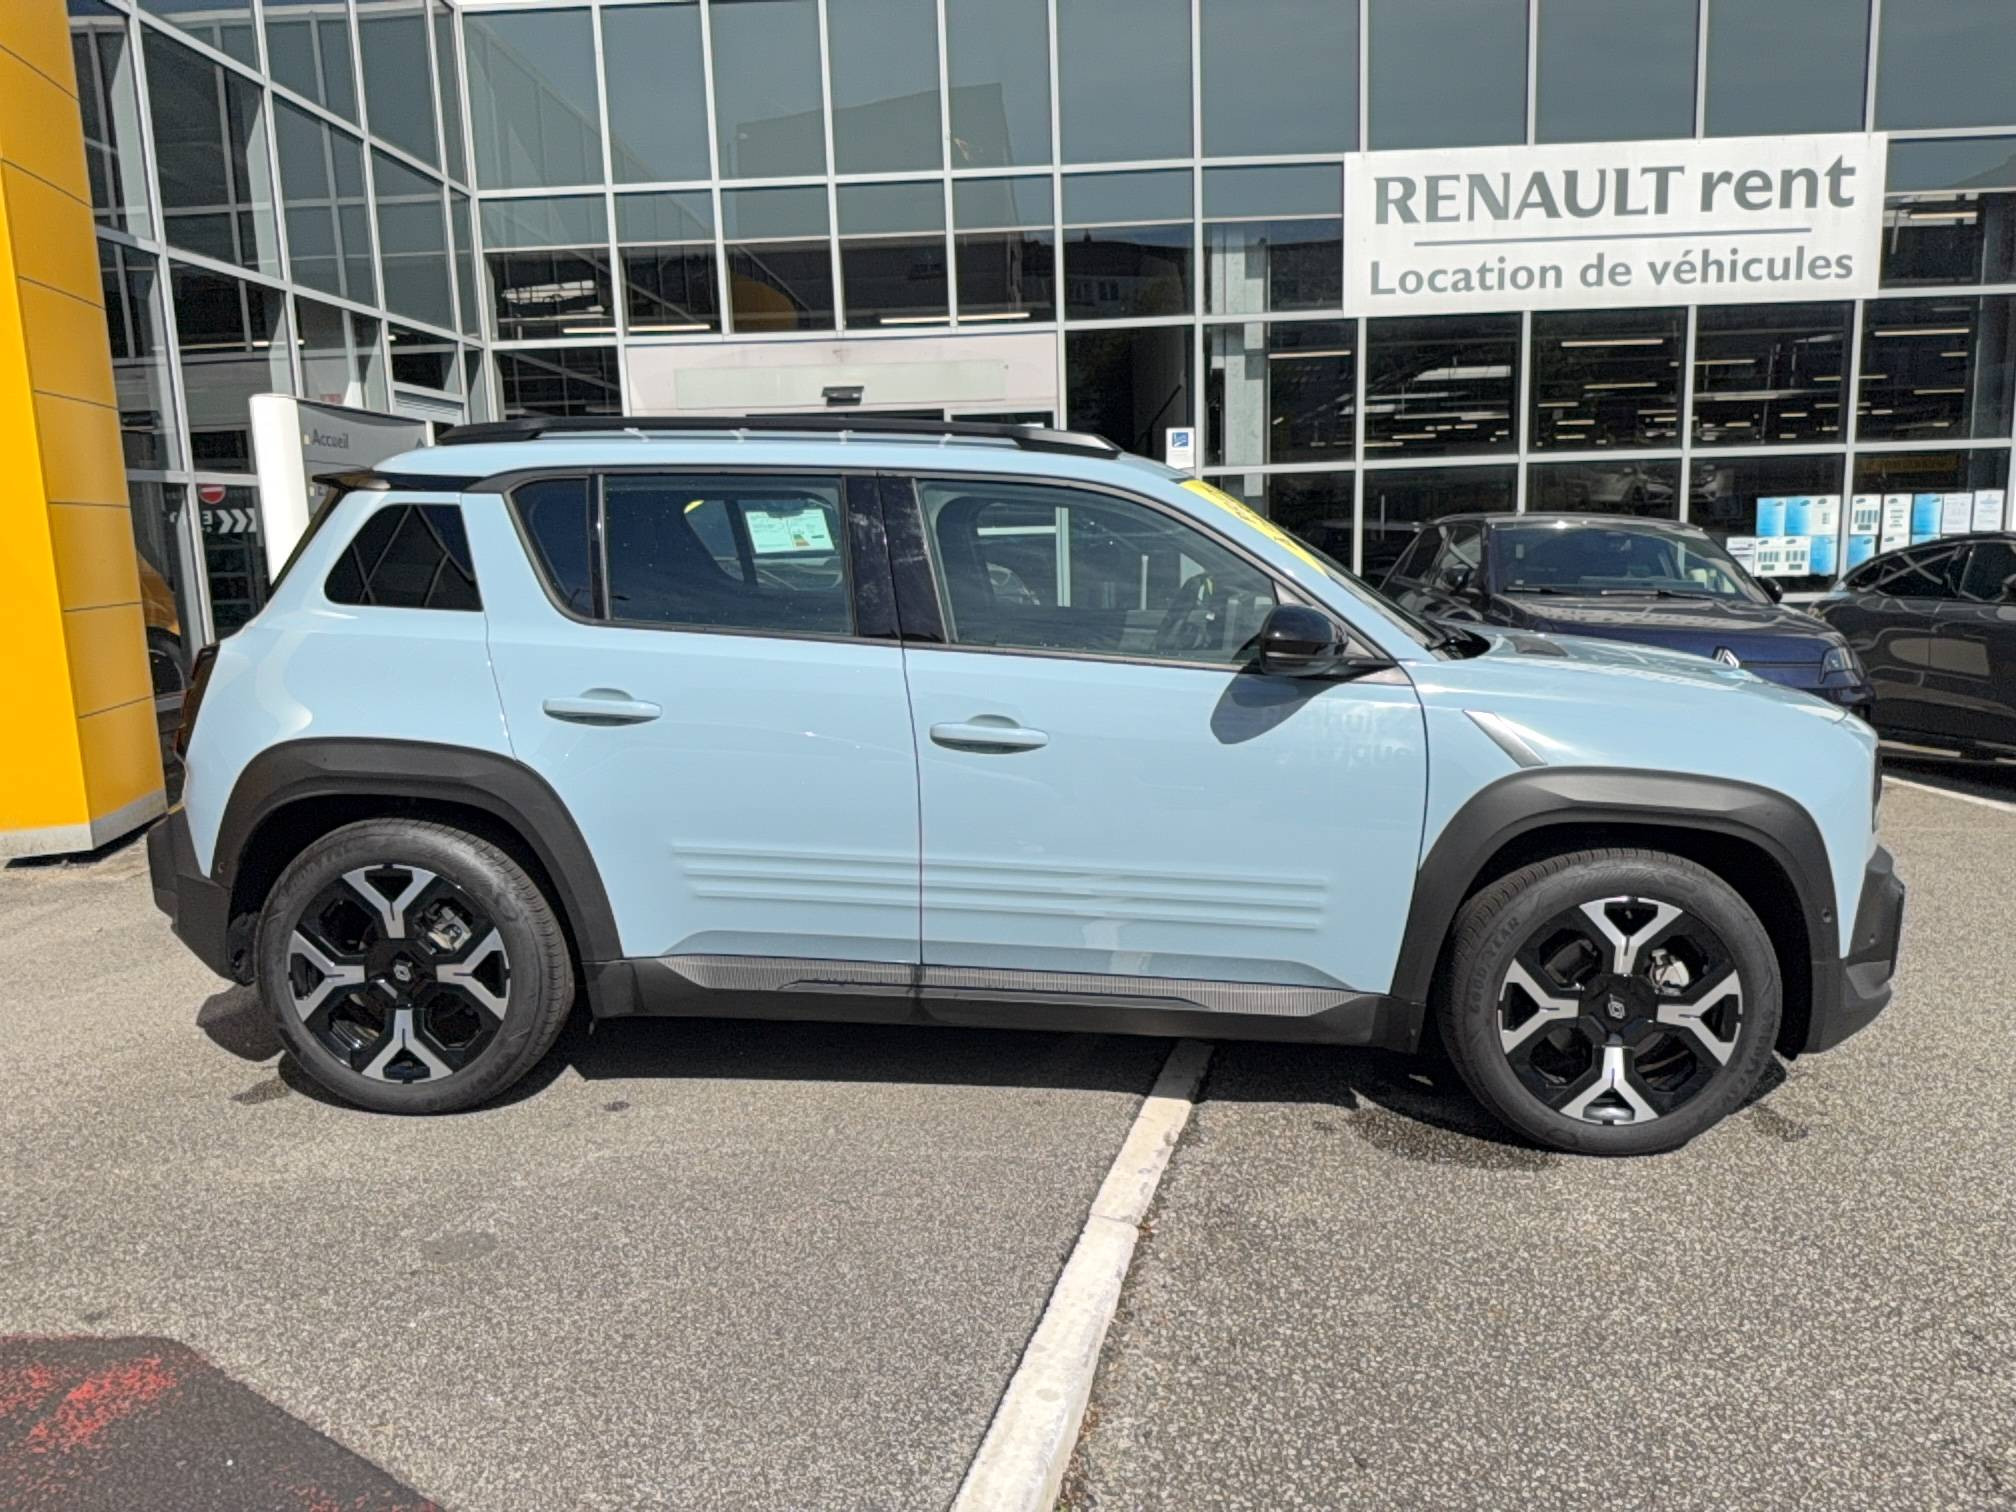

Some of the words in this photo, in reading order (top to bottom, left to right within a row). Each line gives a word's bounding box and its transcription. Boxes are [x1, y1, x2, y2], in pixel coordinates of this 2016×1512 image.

[1373, 165, 1685, 225] RENAULT
[1700, 154, 1856, 213] rent
[1370, 255, 1563, 296] Location
[1579, 252, 1632, 288] de
[1647, 245, 1853, 286] véhicules
[312, 428, 349, 449] Accueil
